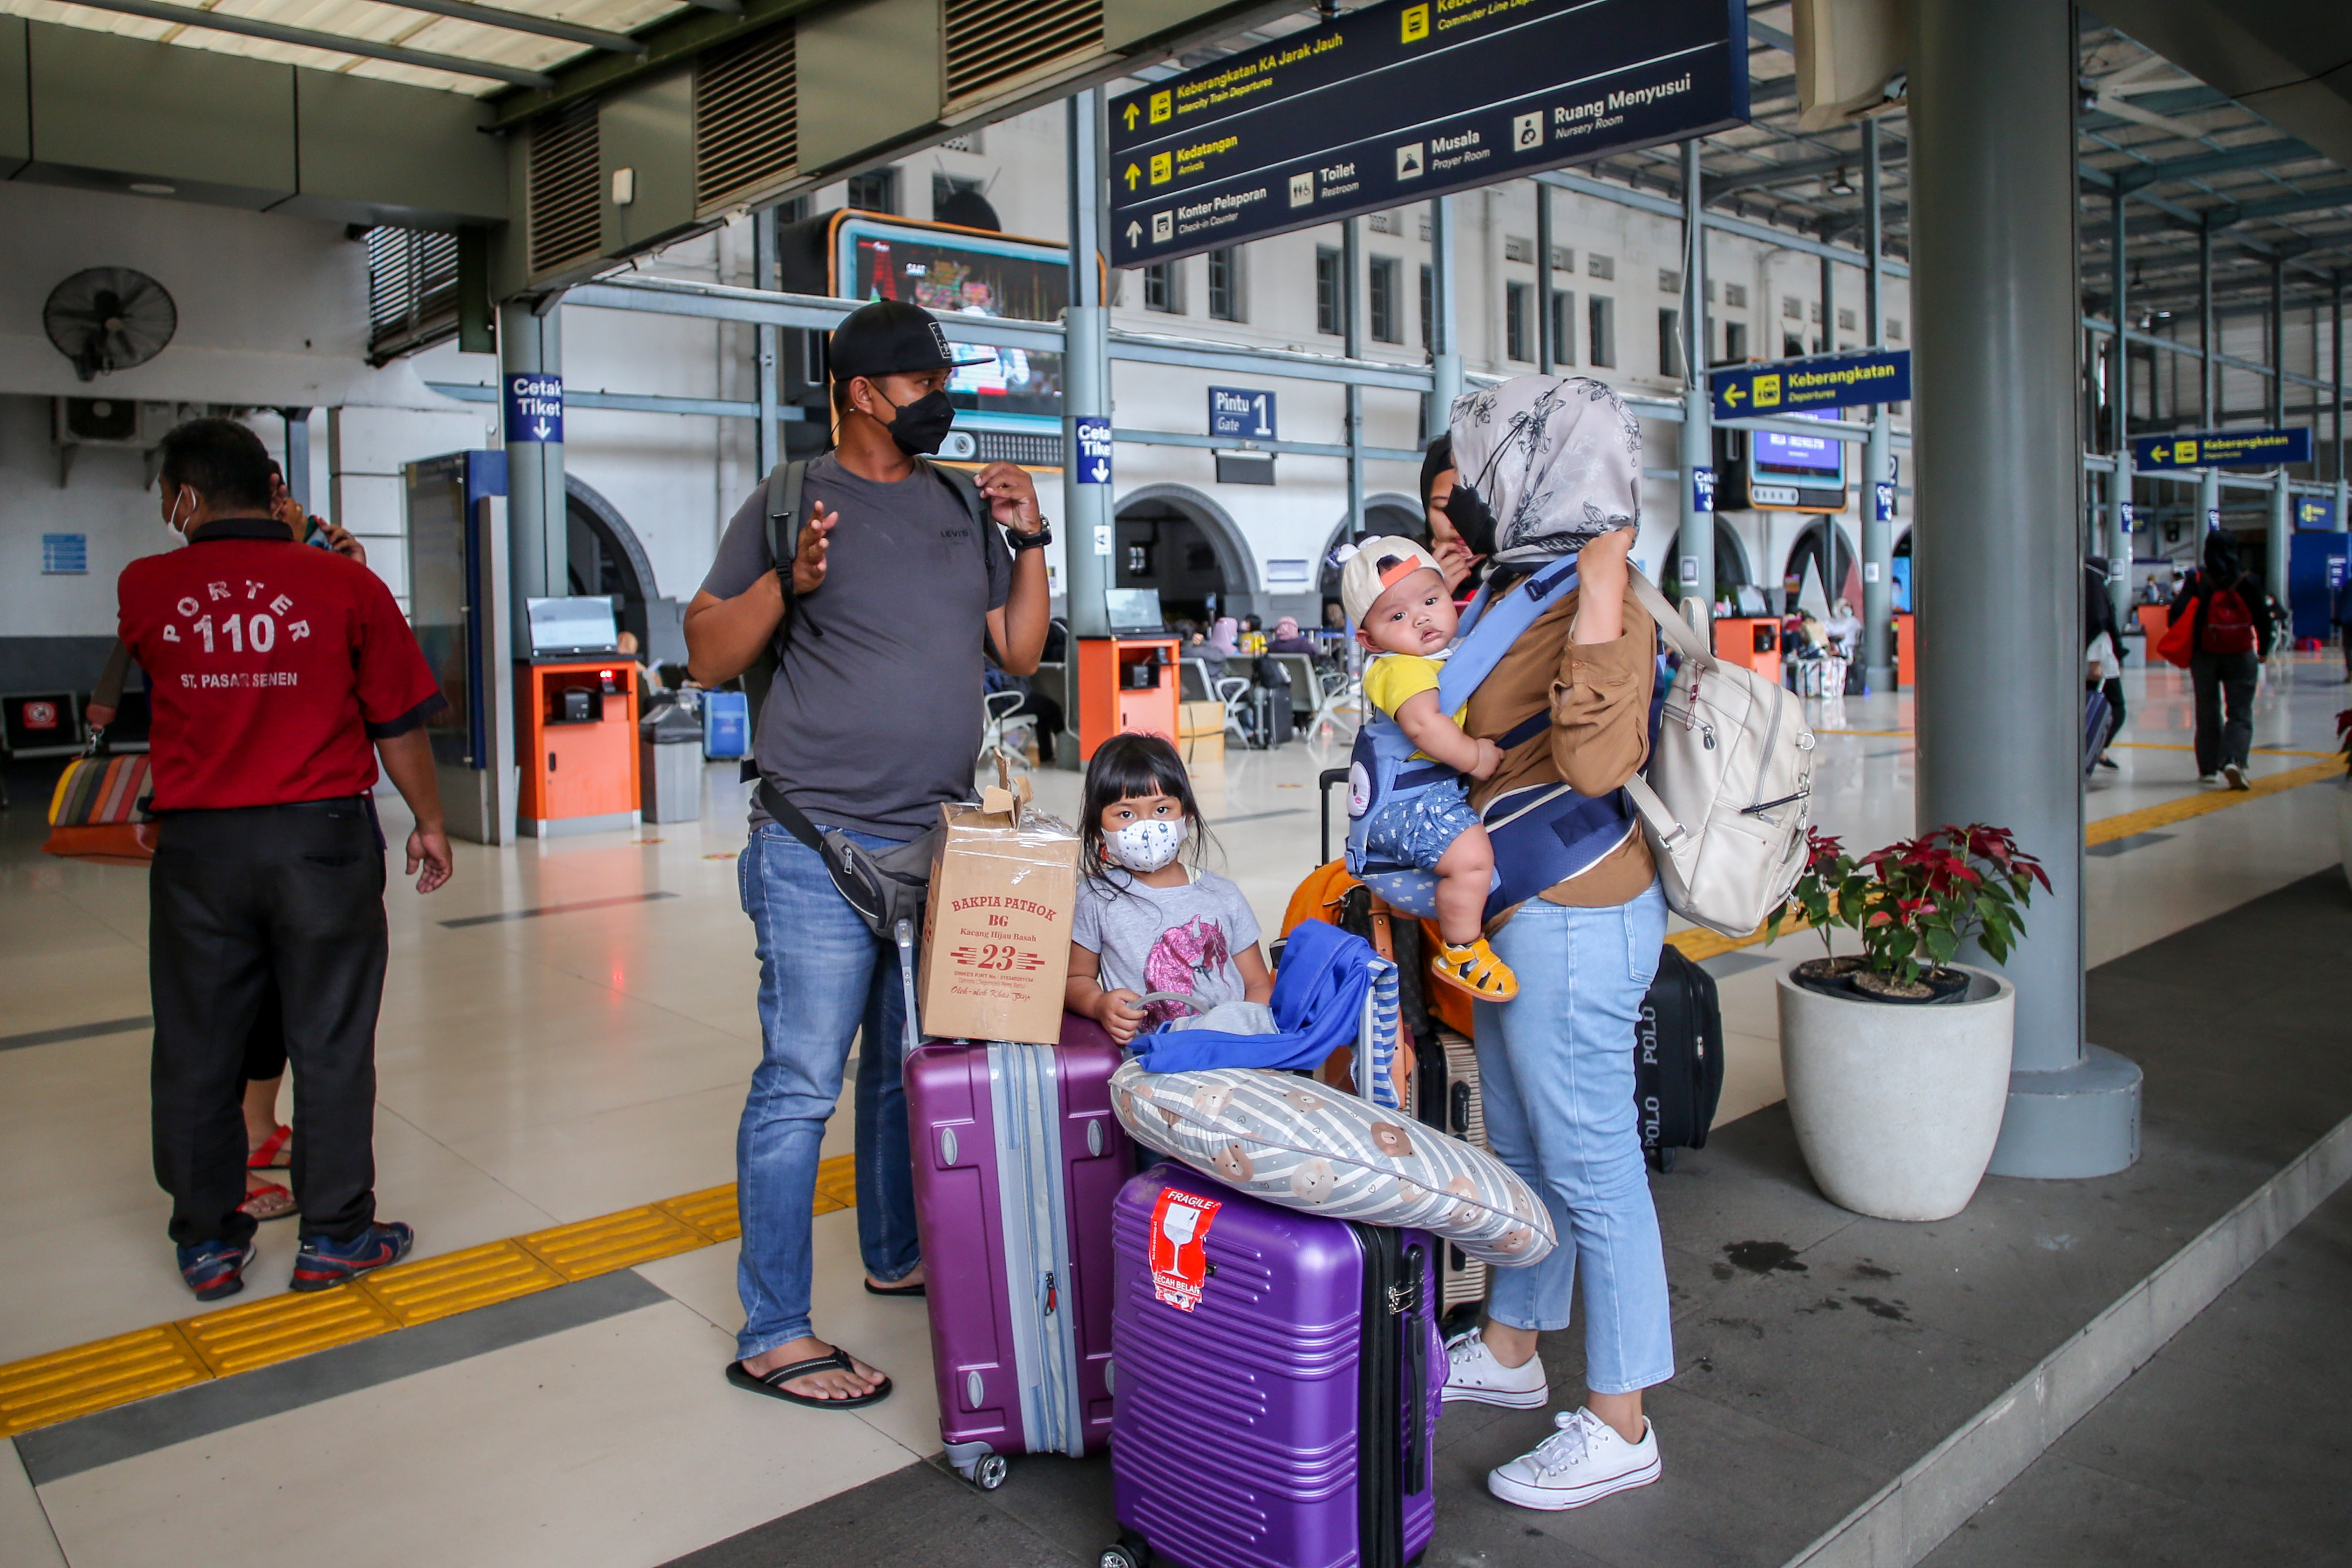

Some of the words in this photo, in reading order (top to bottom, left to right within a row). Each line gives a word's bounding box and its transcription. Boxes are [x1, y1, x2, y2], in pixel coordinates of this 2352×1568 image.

[1438, 8, 1487, 30] Commuter
[1488, 1, 1509, 15] Line
[1176, 63, 1257, 99] Keberangkatan
[1259, 55, 1277, 72] KA
[1278, 43, 1311, 65] Jarak
[1313, 32, 1343, 54] Jauh
[1177, 97, 1209, 114] Intercity
[1210, 90, 1228, 104] Train
[1230, 77, 1273, 97] Departures
[1554, 100, 1604, 124] Ruang
[1608, 72, 1691, 110] Menyusui
[1555, 123, 1594, 139] Nursery
[1594, 115, 1624, 130] Room
[1176, 135, 1238, 162] Kedatangan
[1431, 130, 1481, 154] Musala
[1178, 160, 1205, 175] Arrivals
[1432, 155, 1462, 171] Prayer
[1464, 149, 1491, 162] Room
[1320, 162, 1356, 182] Toilet
[1322, 182, 1359, 198] Restroom
[1177, 202, 1212, 220] Konter
[1214, 188, 1267, 211] Pelaporan
[1179, 219, 1209, 234] Check-in
[1210, 212, 1238, 226] Counter
[1787, 363, 1895, 388] Keberangkatan
[513, 378, 562, 398] Cetak
[1787, 388, 1836, 403] Departures
[517, 398, 561, 417] Tiket
[1216, 391, 1250, 412] Pintu
[1253, 393, 1272, 435] 1
[1077, 423, 1111, 441] Ceta
[1217, 416, 1240, 432] Gate
[1081, 440, 1111, 457] Tike
[2204, 436, 2289, 450] Keberangkatan
[163, 579, 310, 642] PORTER
[193, 613, 276, 653] 110
[202, 673, 249, 688] PASAR
[252, 672, 297, 687] SENEN
[951, 896, 1001, 912] BAKPIA
[1004, 897, 1057, 921] PATHOK
[988, 914, 1009, 927] BG
[960, 928, 989, 939] Kacang
[991, 931, 1012, 941] Hijau
[1013, 933, 1037, 942] Basah
[978, 943, 1016, 971] 23
[1642, 1006, 1658, 1064] POLO
[1645, 1096, 1659, 1148] POLO
[1167, 1191, 1214, 1210] FRAGILE
[1157, 1274, 1175, 1288] ECAH
